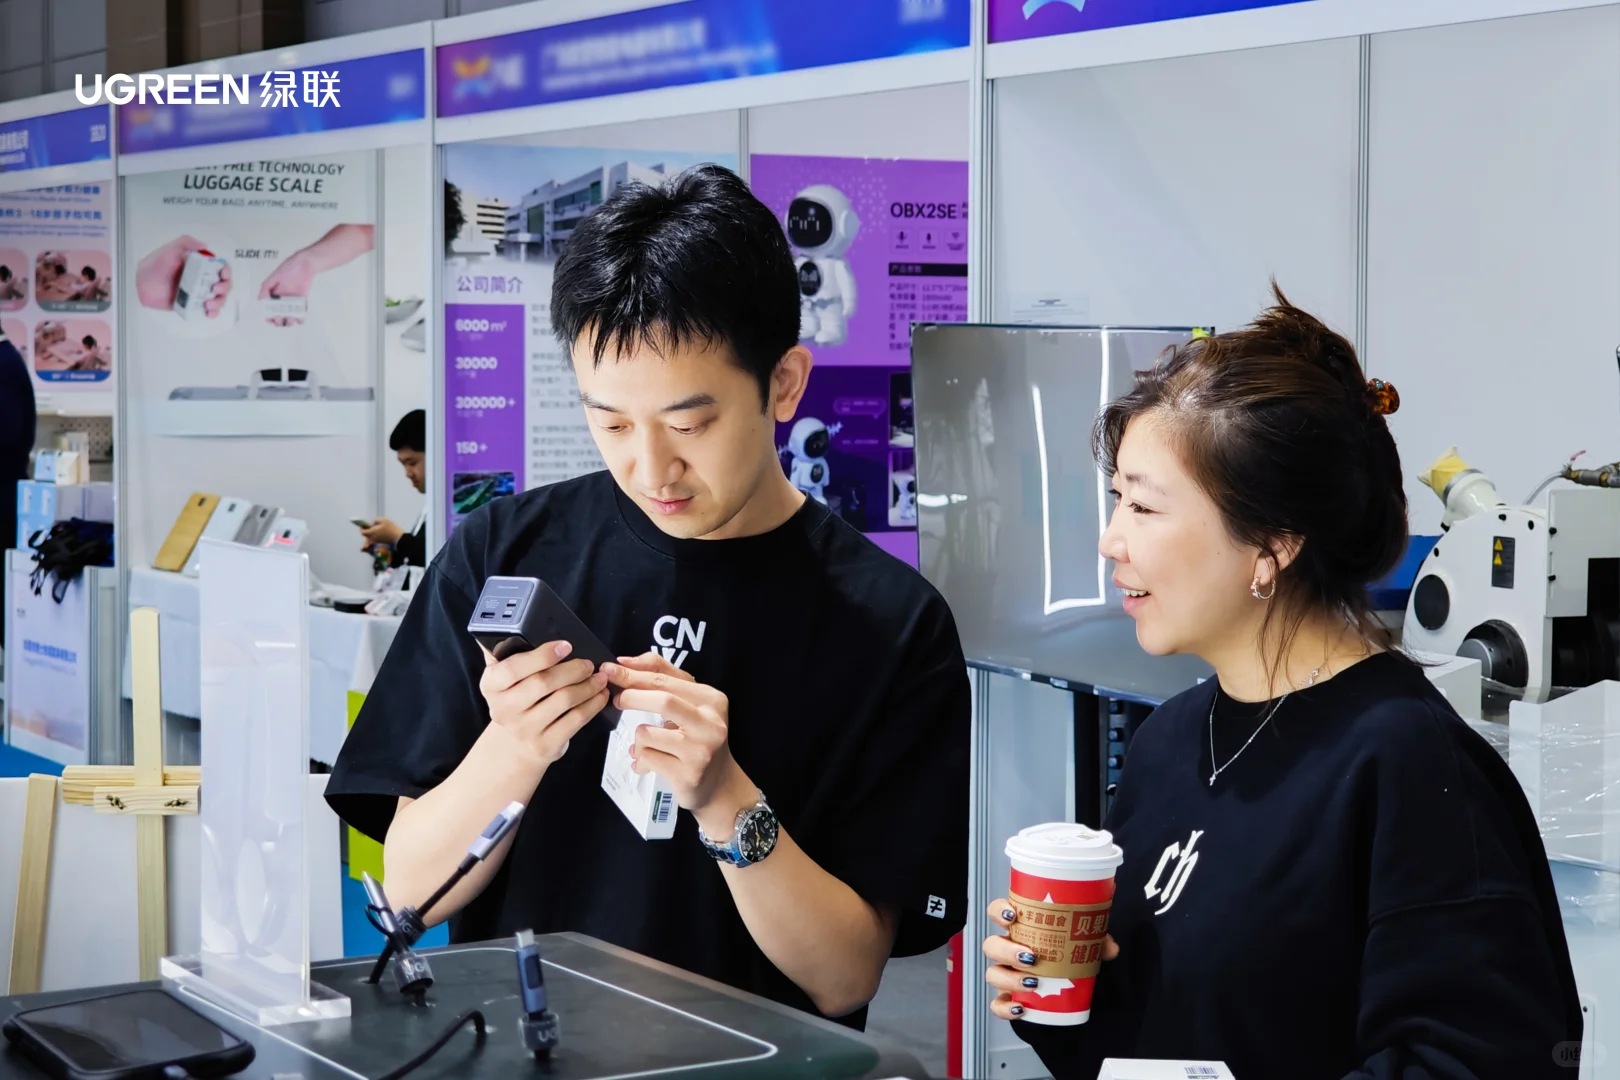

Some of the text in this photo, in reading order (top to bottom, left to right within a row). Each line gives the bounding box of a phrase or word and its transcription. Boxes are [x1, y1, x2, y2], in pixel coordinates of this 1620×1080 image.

[259, 161, 345, 176] TECHNOLOGY
[184, 174, 324, 194] LUGGAGE SCALE
[163, 196, 193, 205] WEIGH
[195, 197, 219, 206] YOUR
[291, 201, 338, 210] ANYWHERE
[890, 202, 957, 219] OBX2SE
[457, 276, 522, 294] 公司简介
[652, 614, 707, 652] CN
